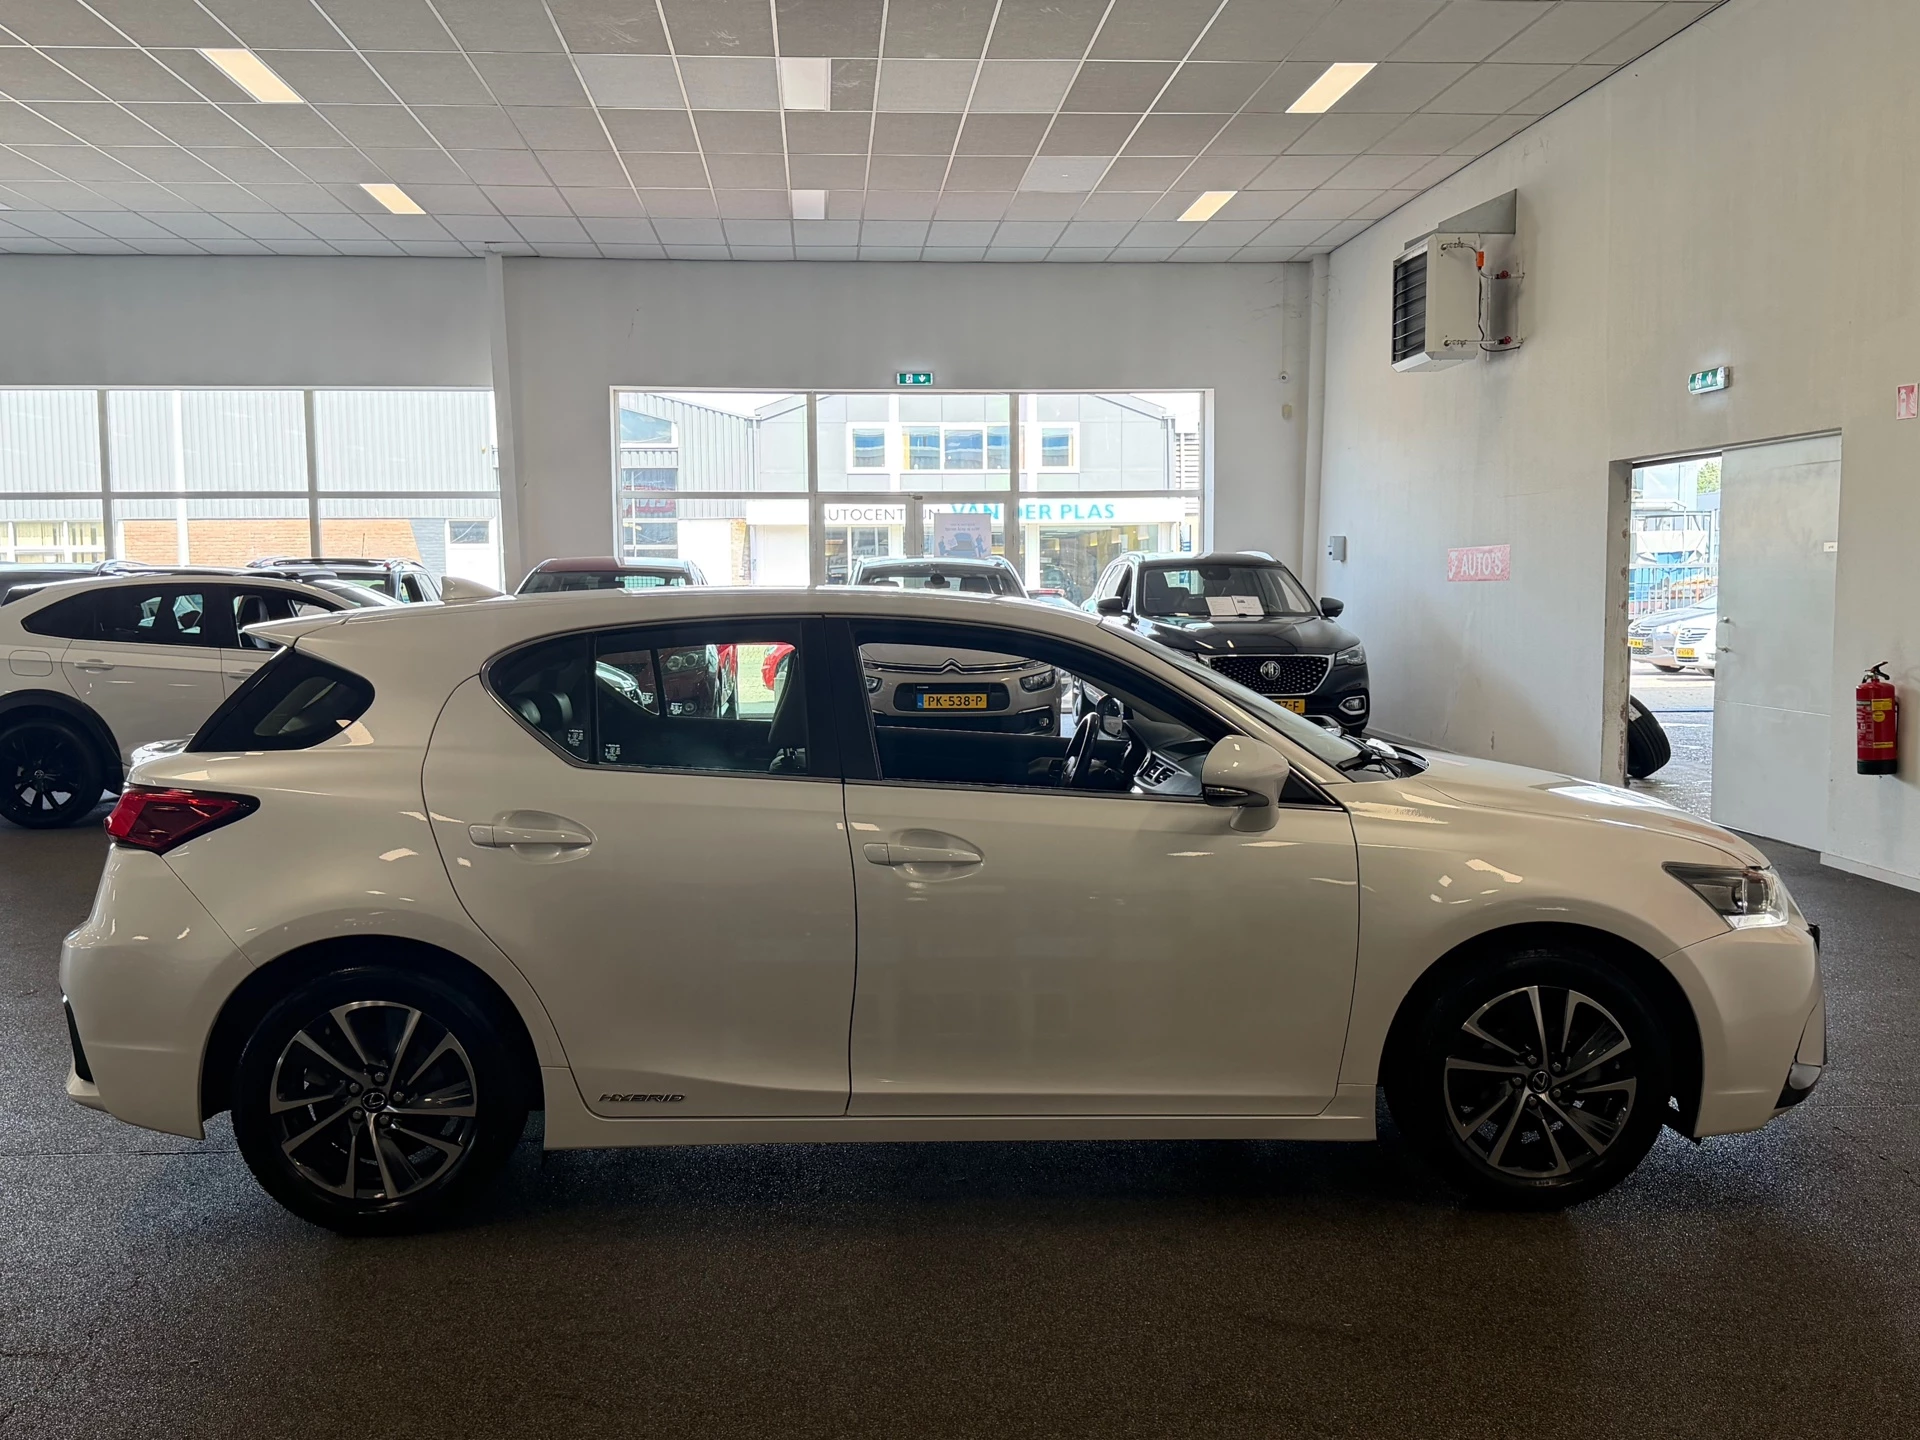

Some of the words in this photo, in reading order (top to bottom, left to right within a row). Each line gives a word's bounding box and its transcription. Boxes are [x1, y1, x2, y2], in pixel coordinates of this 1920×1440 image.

[1017, 503, 1052, 520] ER
[1060, 503, 1115, 520] PLAS
[1460, 552, 1502, 576] AUTO'S
[927, 695, 983, 707] PK-538-P
[599, 1093, 686, 1102] HYBRID
